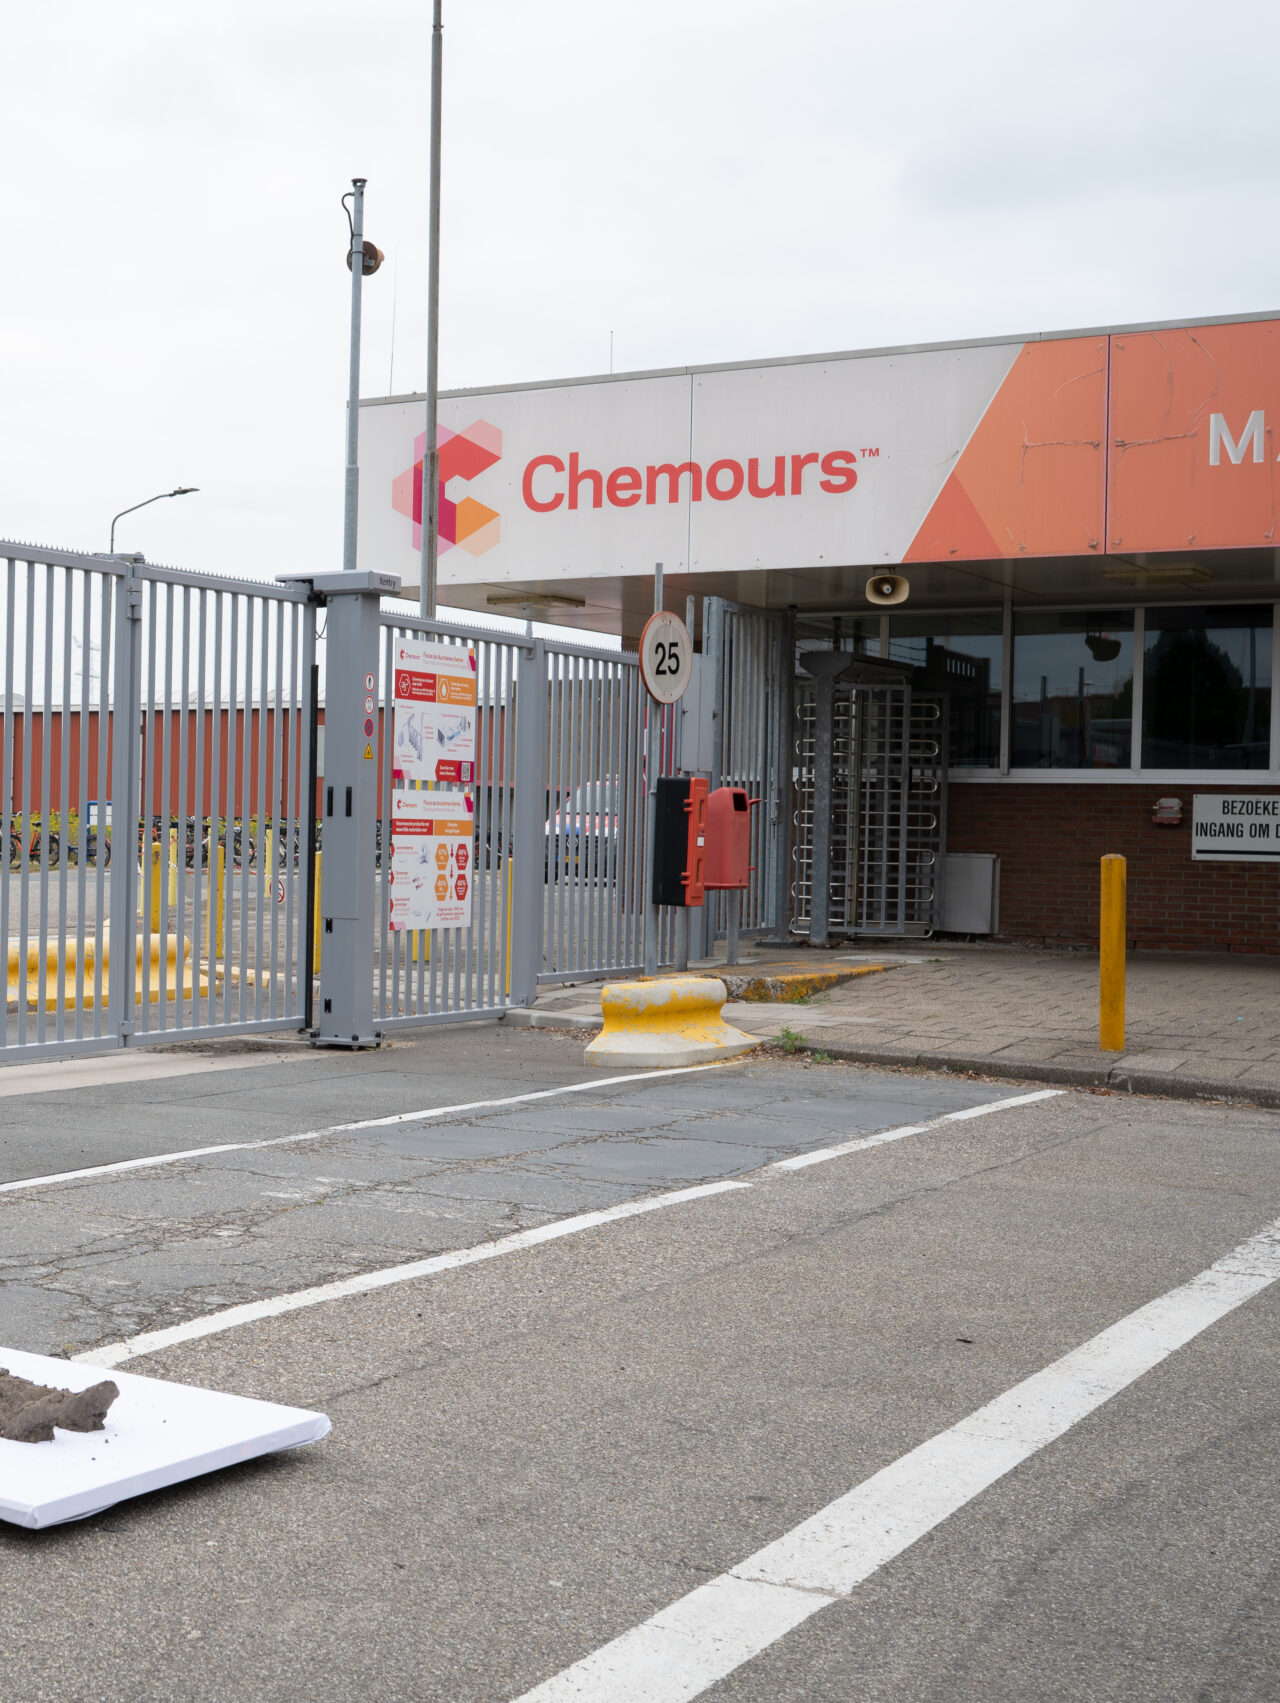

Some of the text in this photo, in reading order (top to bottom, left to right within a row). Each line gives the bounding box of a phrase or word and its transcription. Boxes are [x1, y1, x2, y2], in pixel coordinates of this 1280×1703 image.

[1209, 409, 1280, 466] M
[655, 642, 680, 676] 25
[1195, 822, 1244, 838] INGANG
[1249, 823, 1270, 839] OM
